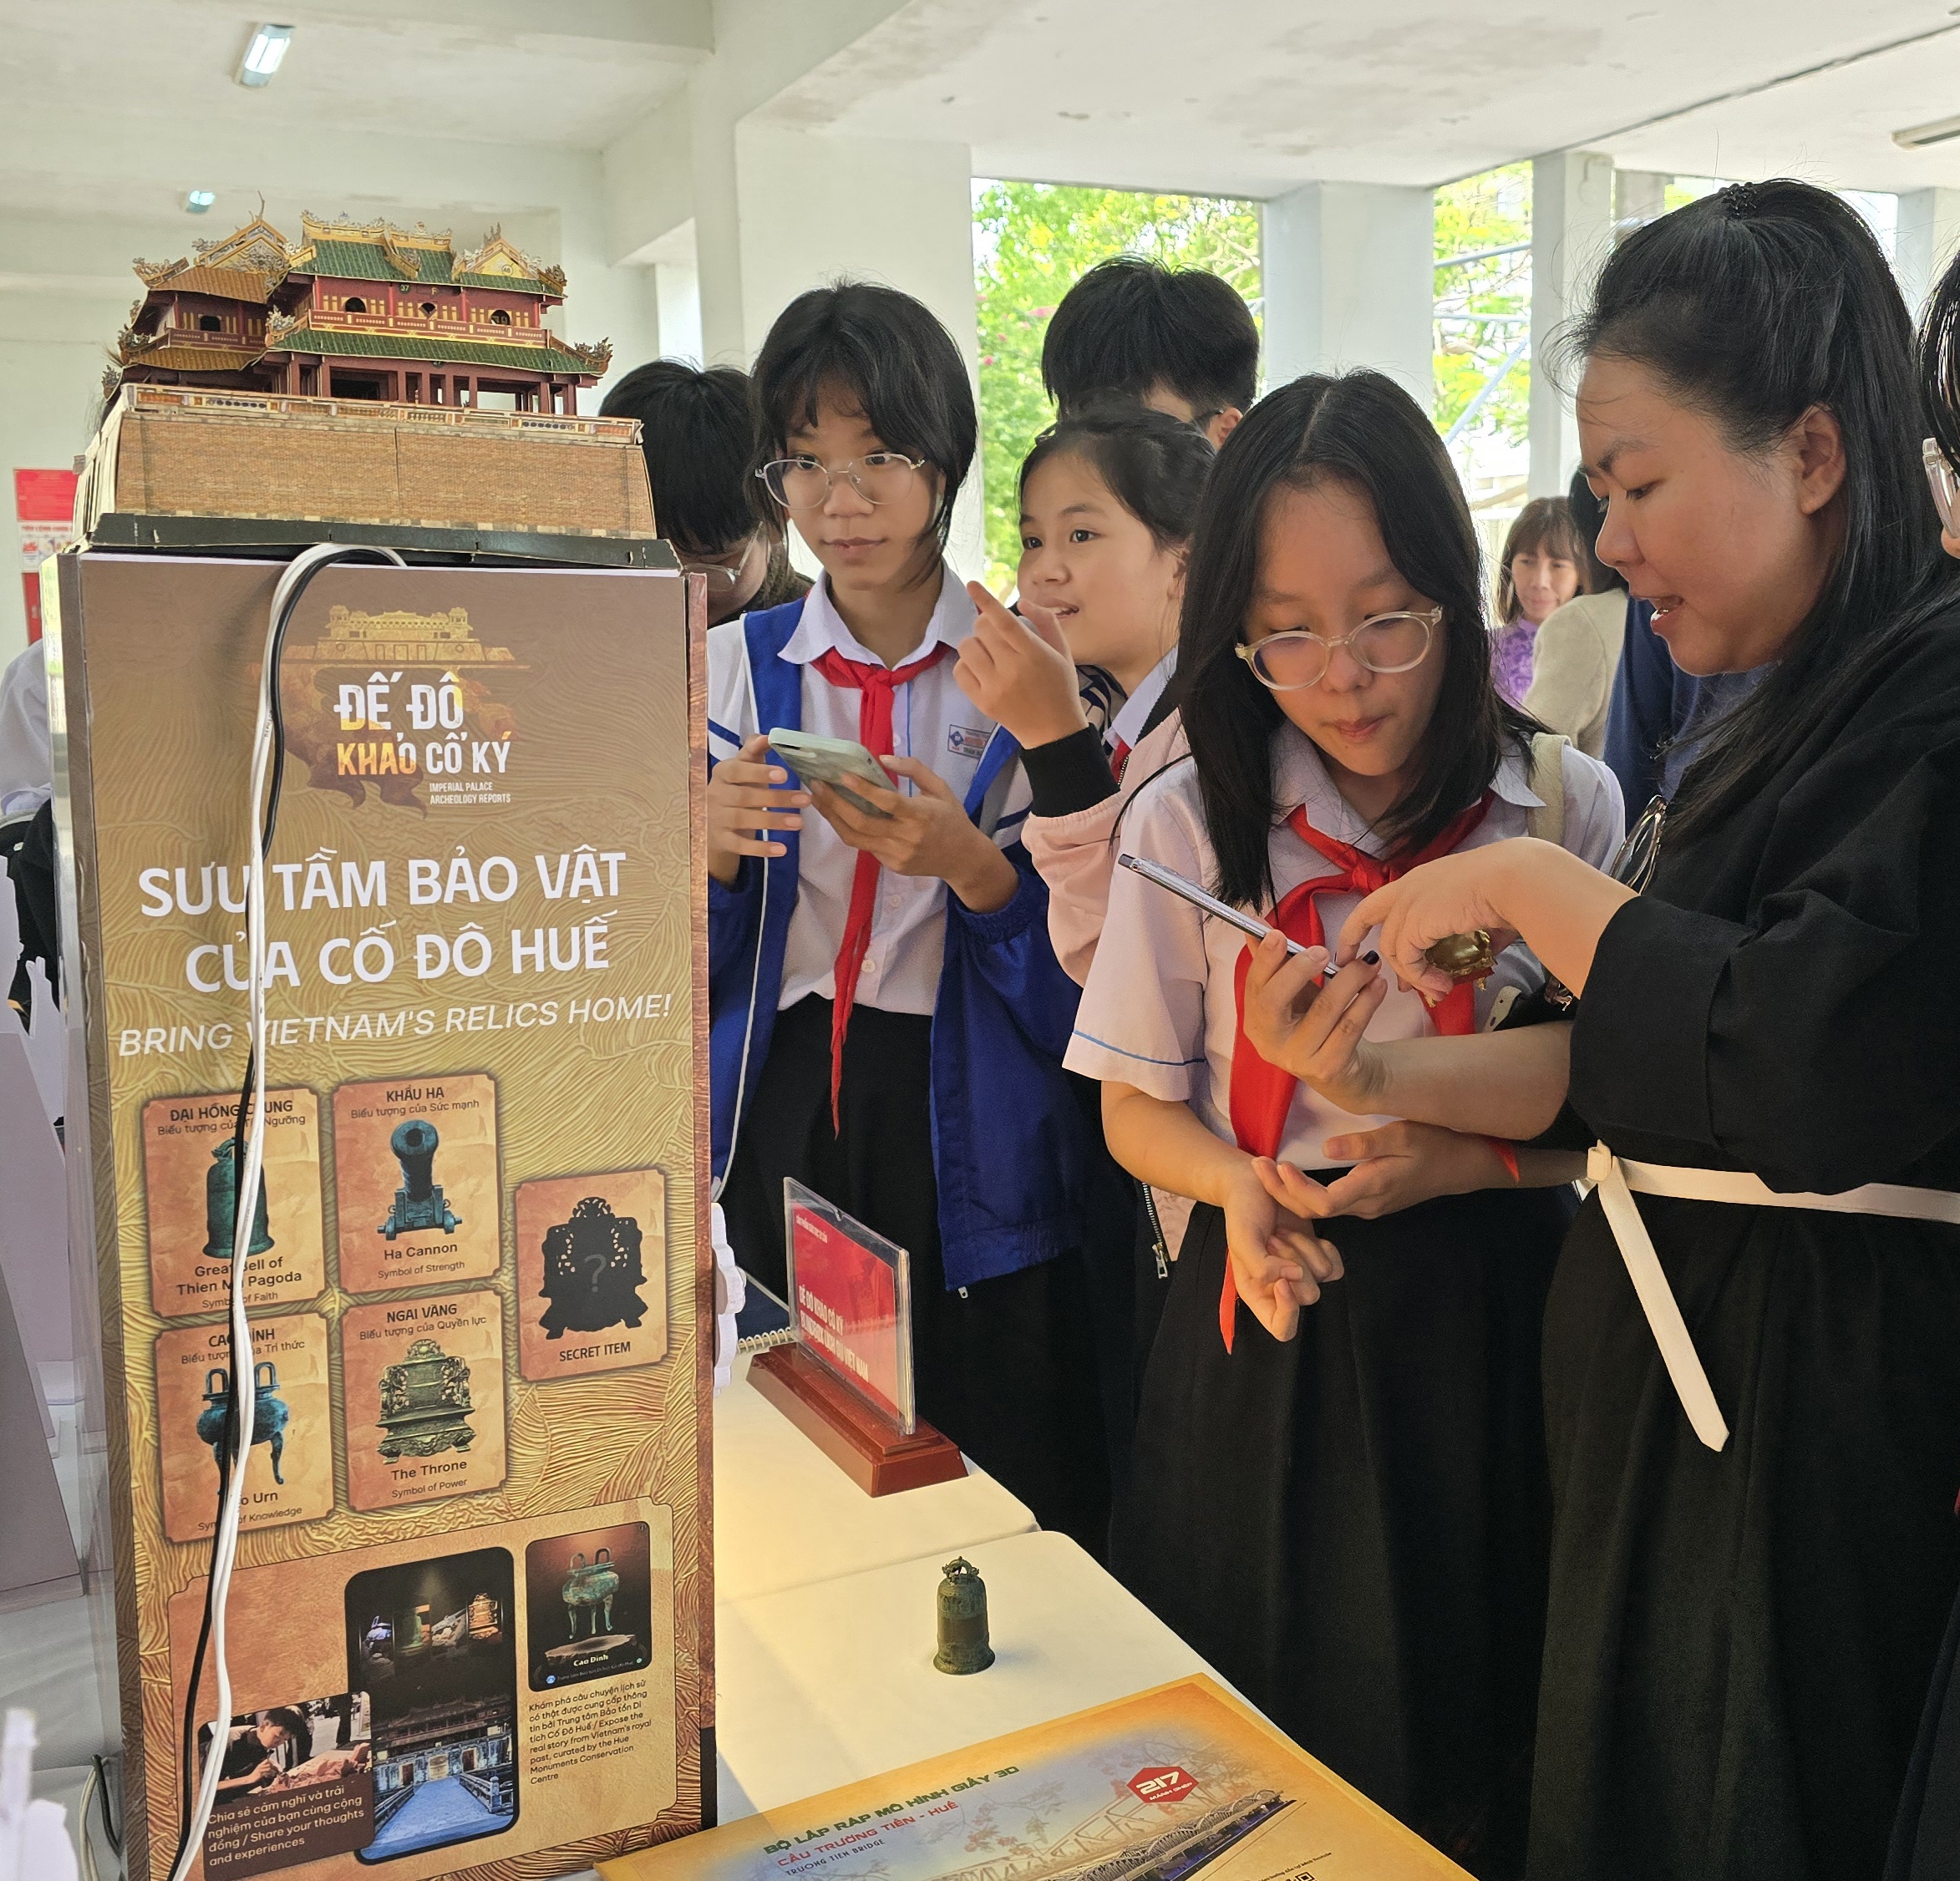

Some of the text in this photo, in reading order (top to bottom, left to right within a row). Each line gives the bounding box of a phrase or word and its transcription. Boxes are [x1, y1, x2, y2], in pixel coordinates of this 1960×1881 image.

[333, 672, 403, 730] ĐẾ
[406, 672, 464, 730] ĐÔ
[337, 731, 511, 775] KHẢO CỔ KÝ
[429, 782, 493, 792] IMPERIAL PALACE
[430, 793, 510, 804] ARCHEOLOGY REPORTS
[139, 844, 626, 917] SƯU TẦM BẢO VẬT
[185, 910, 617, 993] CỦA CỐ ĐÔ HUẾ
[119, 1023, 232, 1057] BRING
[445, 1001, 559, 1032] RELICS
[568, 993, 671, 1024] HOME!
[387, 1084, 444, 1103] KHẨU HẠ
[170, 1108, 193, 1123] ĐẠI
[246, 1100, 292, 1115] CUNG
[351, 1099, 480, 1118] Biểu tượng của Sức mạnh
[269, 1257, 283, 1269] of
[383, 1244, 458, 1260] Ha Cannon
[378, 1261, 465, 1280] Symbol of Strength
[584, 1254, 607, 1293] ?
[176, 1272, 302, 1295] Thien Pagoda
[254, 1292, 278, 1302] Faith
[387, 1304, 457, 1323] NGAI VÀNG
[359, 1316, 486, 1340] Biểu tượng của Quyền lực
[281, 1341, 305, 1351] thức
[560, 1341, 631, 1361] SECRET ITEM
[391, 1461, 467, 1480] The Throne
[253, 1492, 278, 1503] Urn
[392, 1478, 467, 1498] Symbol of Power
[250, 1508, 302, 1522] Knowledge
[529, 1702, 553, 1711] Khám
[555, 1696, 571, 1707] phá
[590, 1686, 618, 1698] chuyện
[621, 1683, 634, 1692] lịch
[637, 1679, 646, 1687] sử
[542, 1711, 559, 1719] thật
[561, 1705, 582, 1715] được
[584, 1701, 604, 1711] cung
[606, 1696, 622, 1706] cấp
[623, 1691, 647, 1701] thông
[556, 1716, 580, 1726] Trung
[600, 1707, 617, 1716] Bảo
[618, 1703, 632, 1712] tồn
[633, 1701, 642, 1709] Di
[530, 1733, 546, 1742] tích
[548, 1728, 560, 1739] Cố
[561, 1727, 574, 1736] Đô
[576, 1721, 592, 1732] Huế
[599, 1716, 628, 1727] Expose
[530, 1719, 652, 1753] real story from Vietnam's royal
[530, 1754, 551, 1765] past,
[553, 1745, 585, 1758] curated
[531, 1746, 634, 1774] Monuments Conservation
[531, 1773, 558, 1784] Centre
[1136, 1772, 1179, 1794] 217
[208, 1785, 344, 1824] Chia sẻ cảm nghĩ và trải
[764, 1839, 792, 1854] BỘ
[874, 1803, 904, 1818] MÔ
[994, 1766, 1019, 1777] 3D
[208, 1796, 362, 1839] nghiệm của bạn cùng cộng
[209, 1809, 364, 1853] đồng Share your thoughts
[210, 1838, 305, 1866] and experiences
[785, 1839, 885, 1876] TRUONG TIEN BRIDGE
